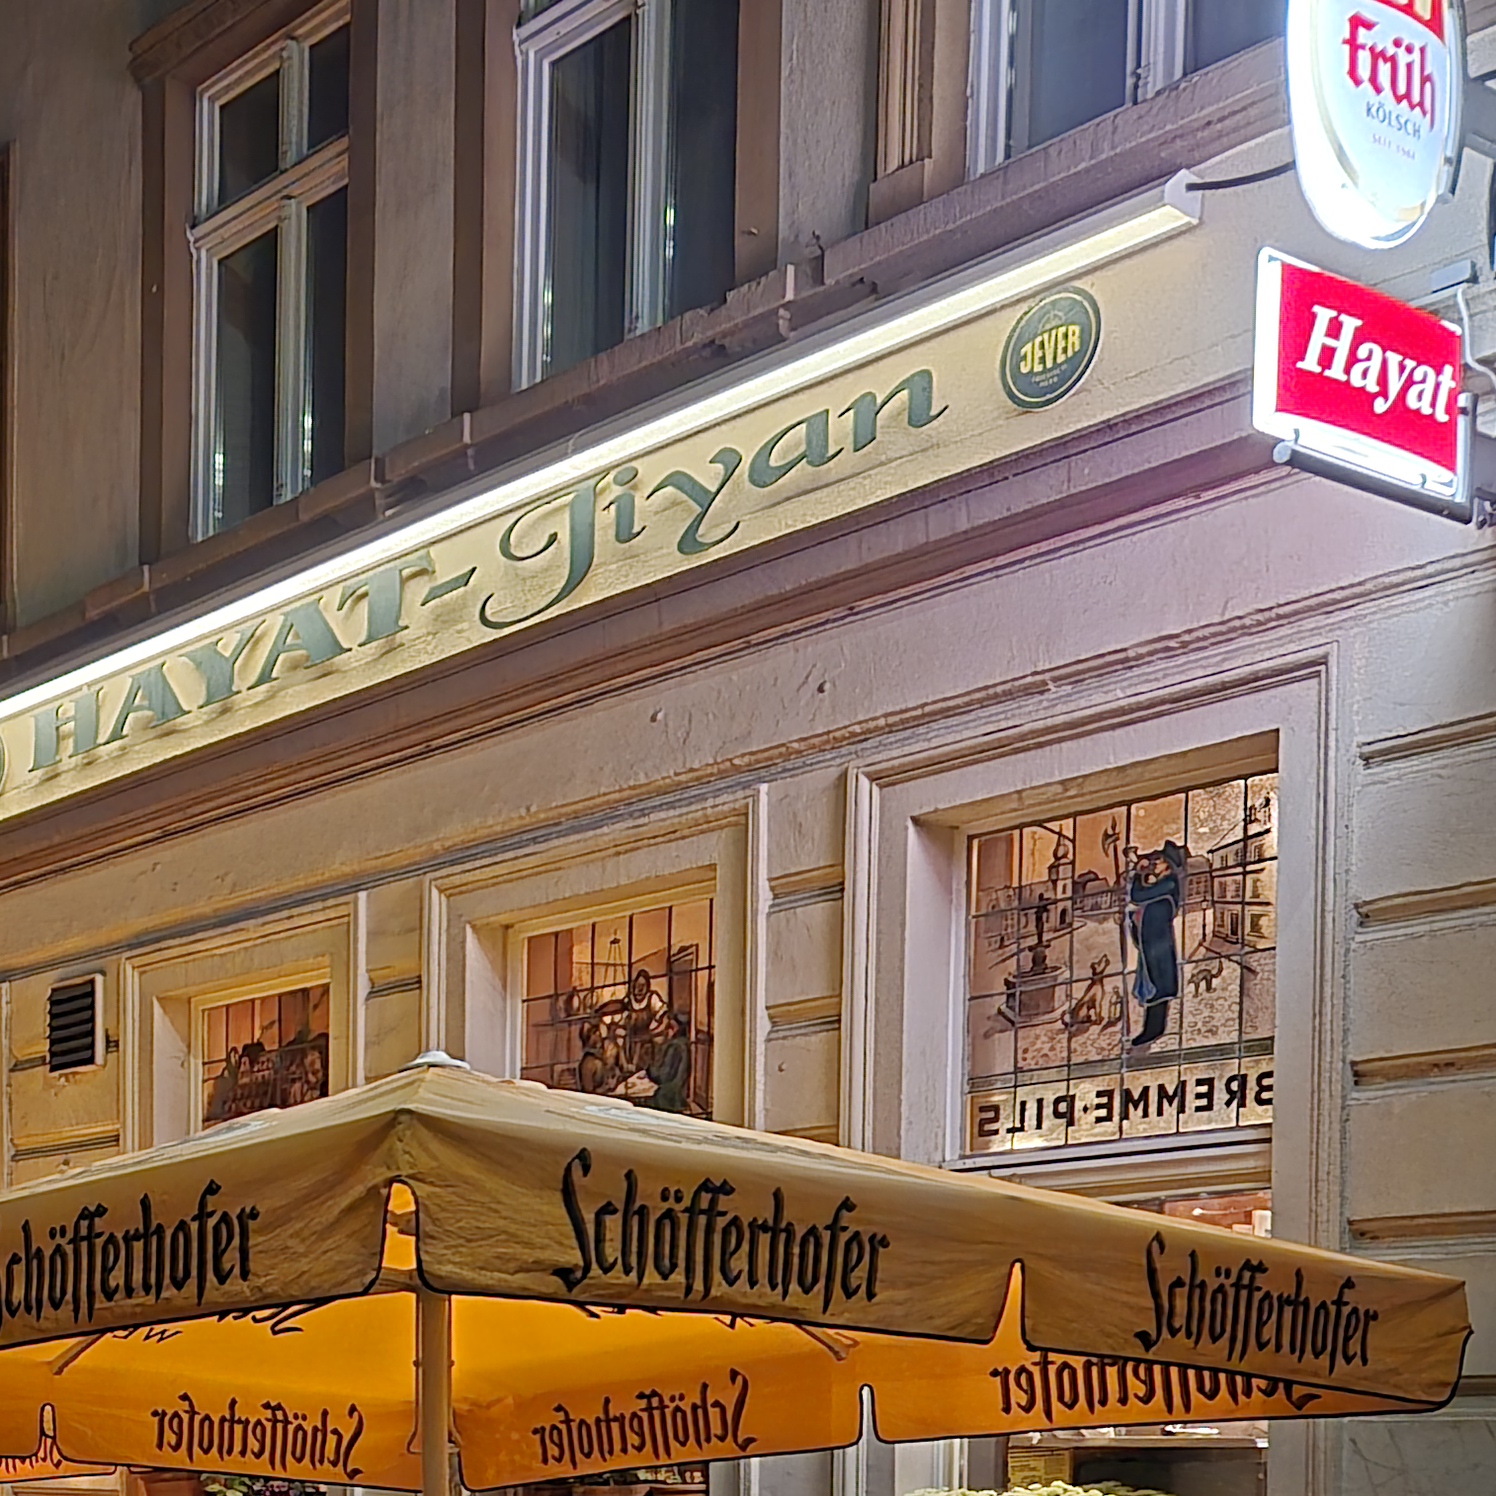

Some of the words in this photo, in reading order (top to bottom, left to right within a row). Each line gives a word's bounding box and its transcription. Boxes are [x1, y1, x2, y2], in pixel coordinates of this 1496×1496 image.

[1366, 101, 1421, 140] KÖLSCH
[1020, 324, 1081, 374] JEVER
[1297, 304, 1457, 423] Hayat
[552, 1147, 890, 1315] Schöfferhofer
[1134, 1231, 1379, 1376] Schöfferhofer
